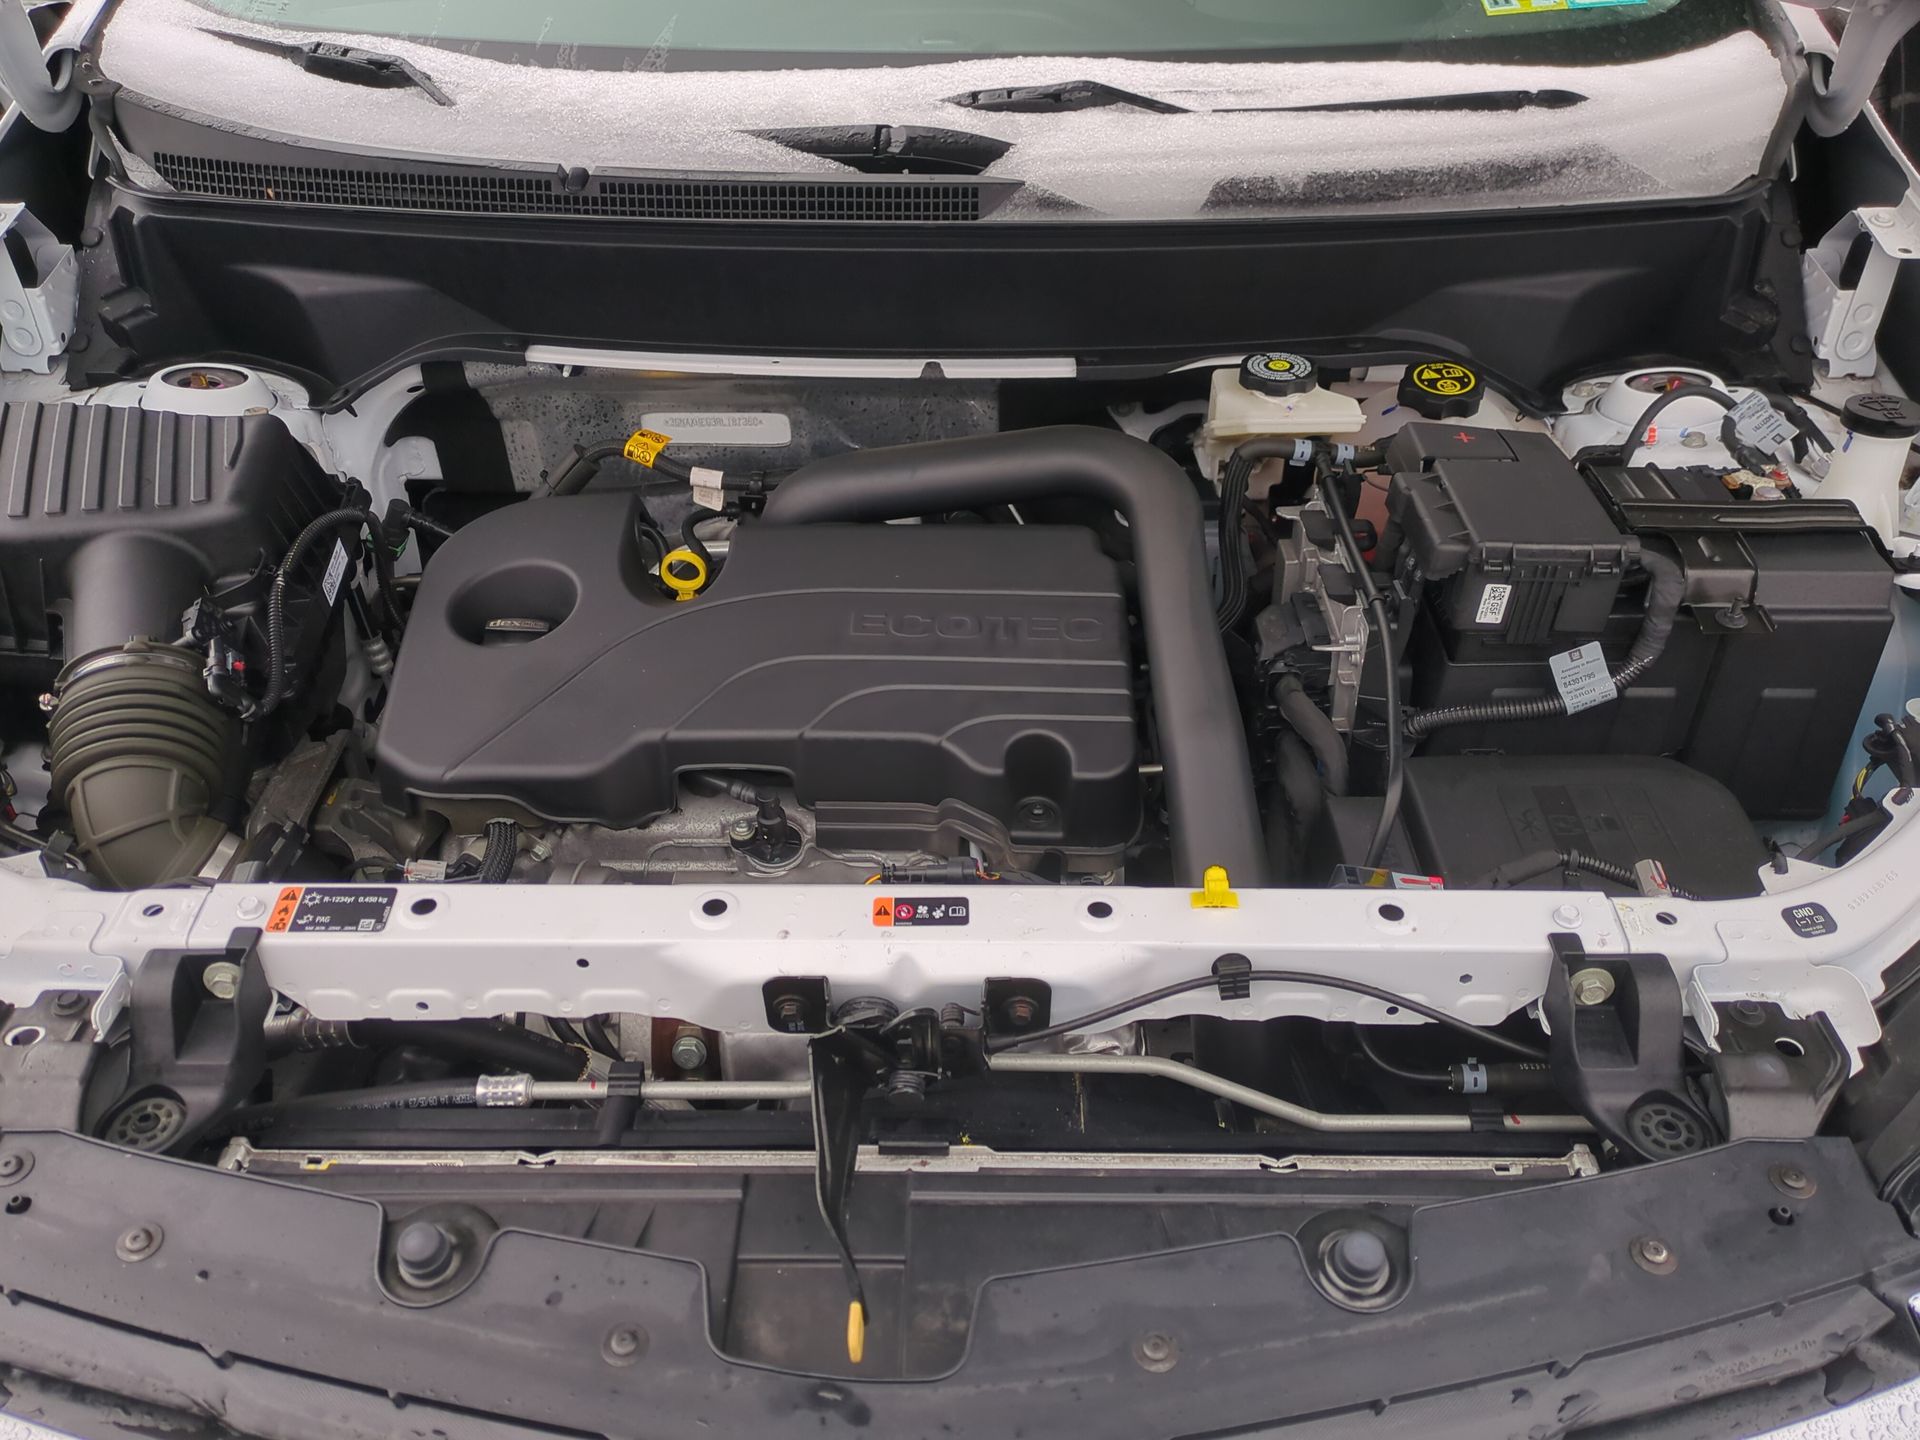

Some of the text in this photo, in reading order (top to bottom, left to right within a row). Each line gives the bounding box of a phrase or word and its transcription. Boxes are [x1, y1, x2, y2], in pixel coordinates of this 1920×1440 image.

[850, 613, 1104, 642] ECOTEC
[323, 896, 355, 905] R-1234yf
[379, 896, 388, 904] kg
[1792, 906, 1814, 919] GND
[315, 915, 331, 923] PAG
